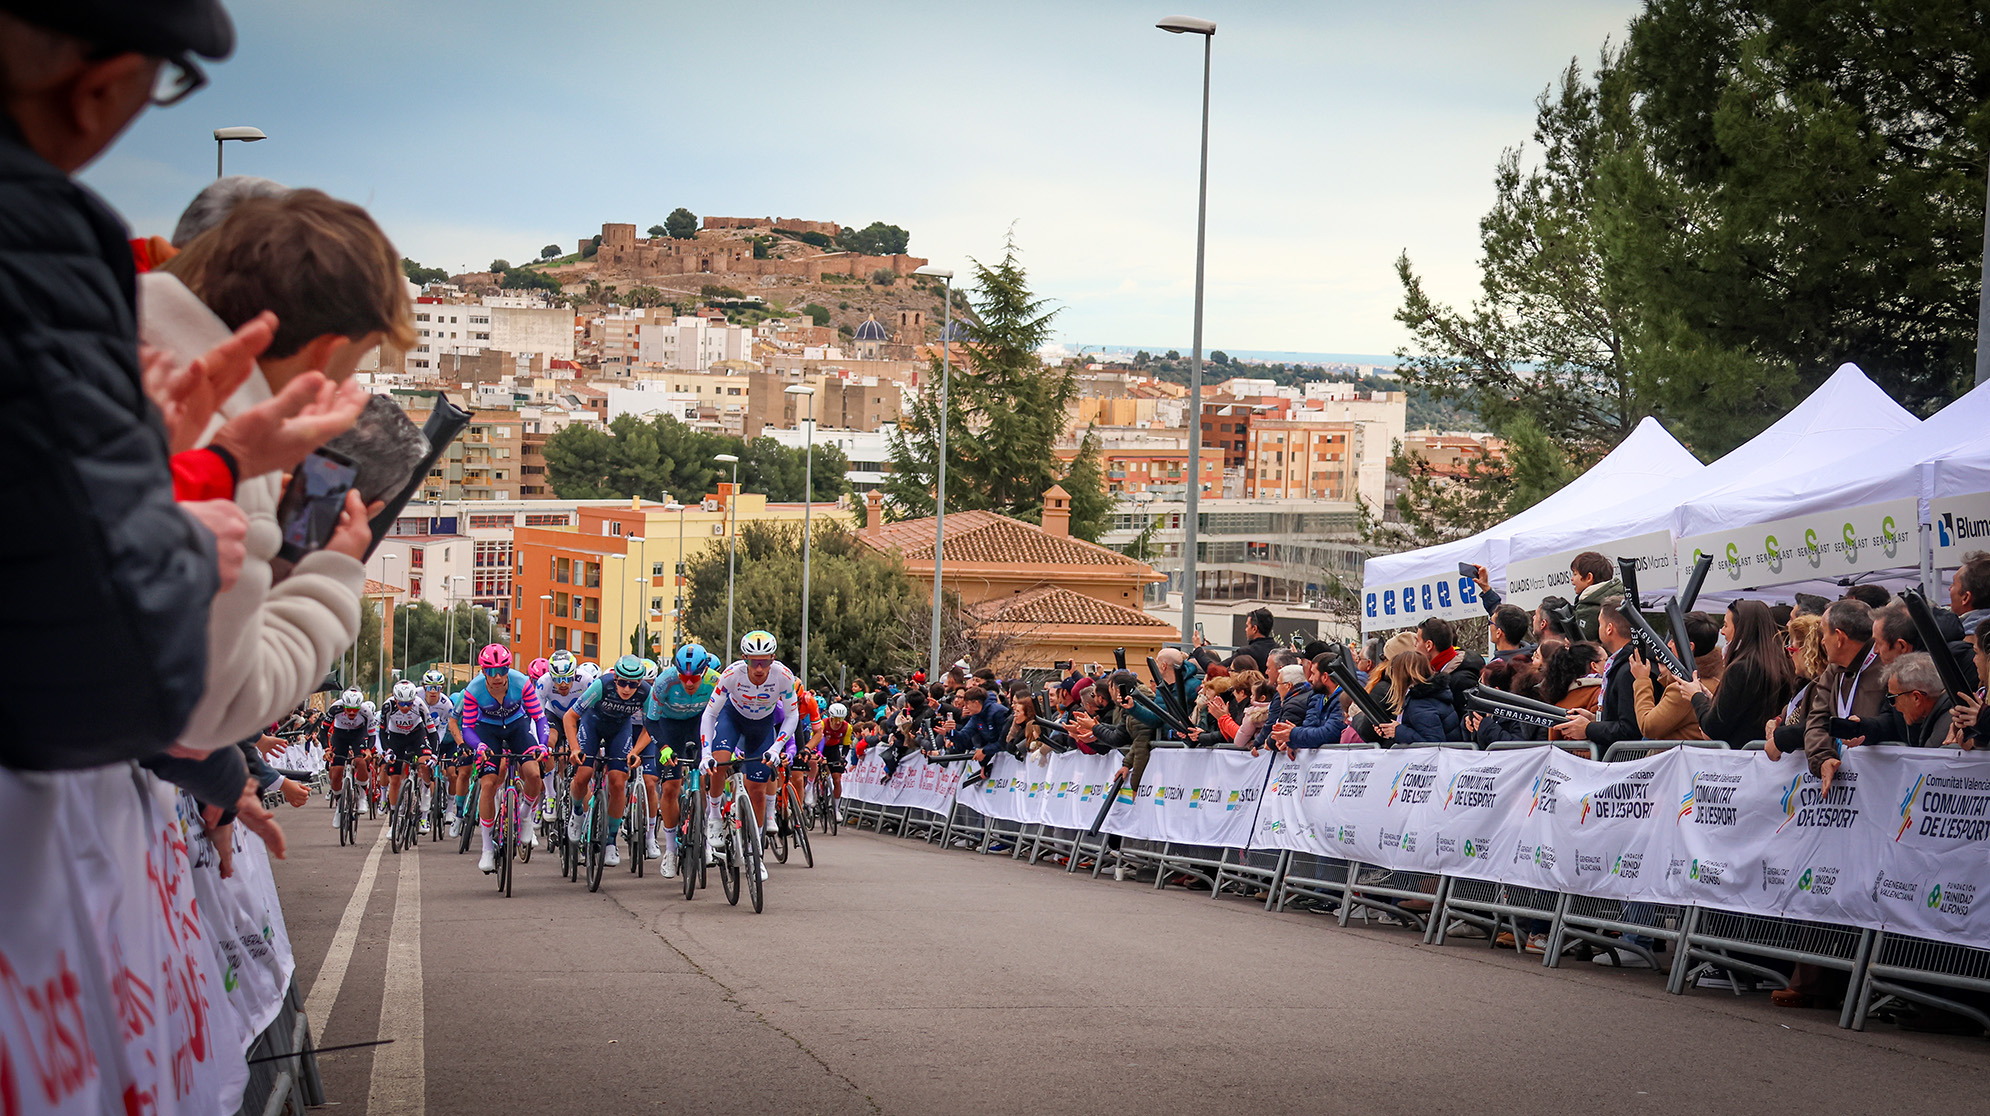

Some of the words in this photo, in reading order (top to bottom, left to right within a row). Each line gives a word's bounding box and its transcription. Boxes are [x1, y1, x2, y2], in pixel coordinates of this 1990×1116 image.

[1956, 516, 1990, 539] Blum
[1510, 578, 1529, 594] QUADIS
[1547, 571, 1570, 587] QUADIS
[602, 701, 641, 711] BAHRAIN
[1457, 774, 1496, 791] COMUNITAT
[1925, 774, 1963, 790] Comunitat
[1401, 789, 1413, 803] DE
[1454, 791, 1464, 805] DE
[1695, 785, 1737, 804] COMUNITAT
[1596, 801, 1609, 818] DE
[1922, 791, 1990, 816] COMUNITAT
[1919, 815, 1941, 837] DE
[1883, 879, 1918, 892] GENERALITAT
[1880, 888, 1914, 902] VALENCIANA
[1943, 891, 1974, 905] TRINIDAD
[1939, 903, 1969, 916] ALFONSO
